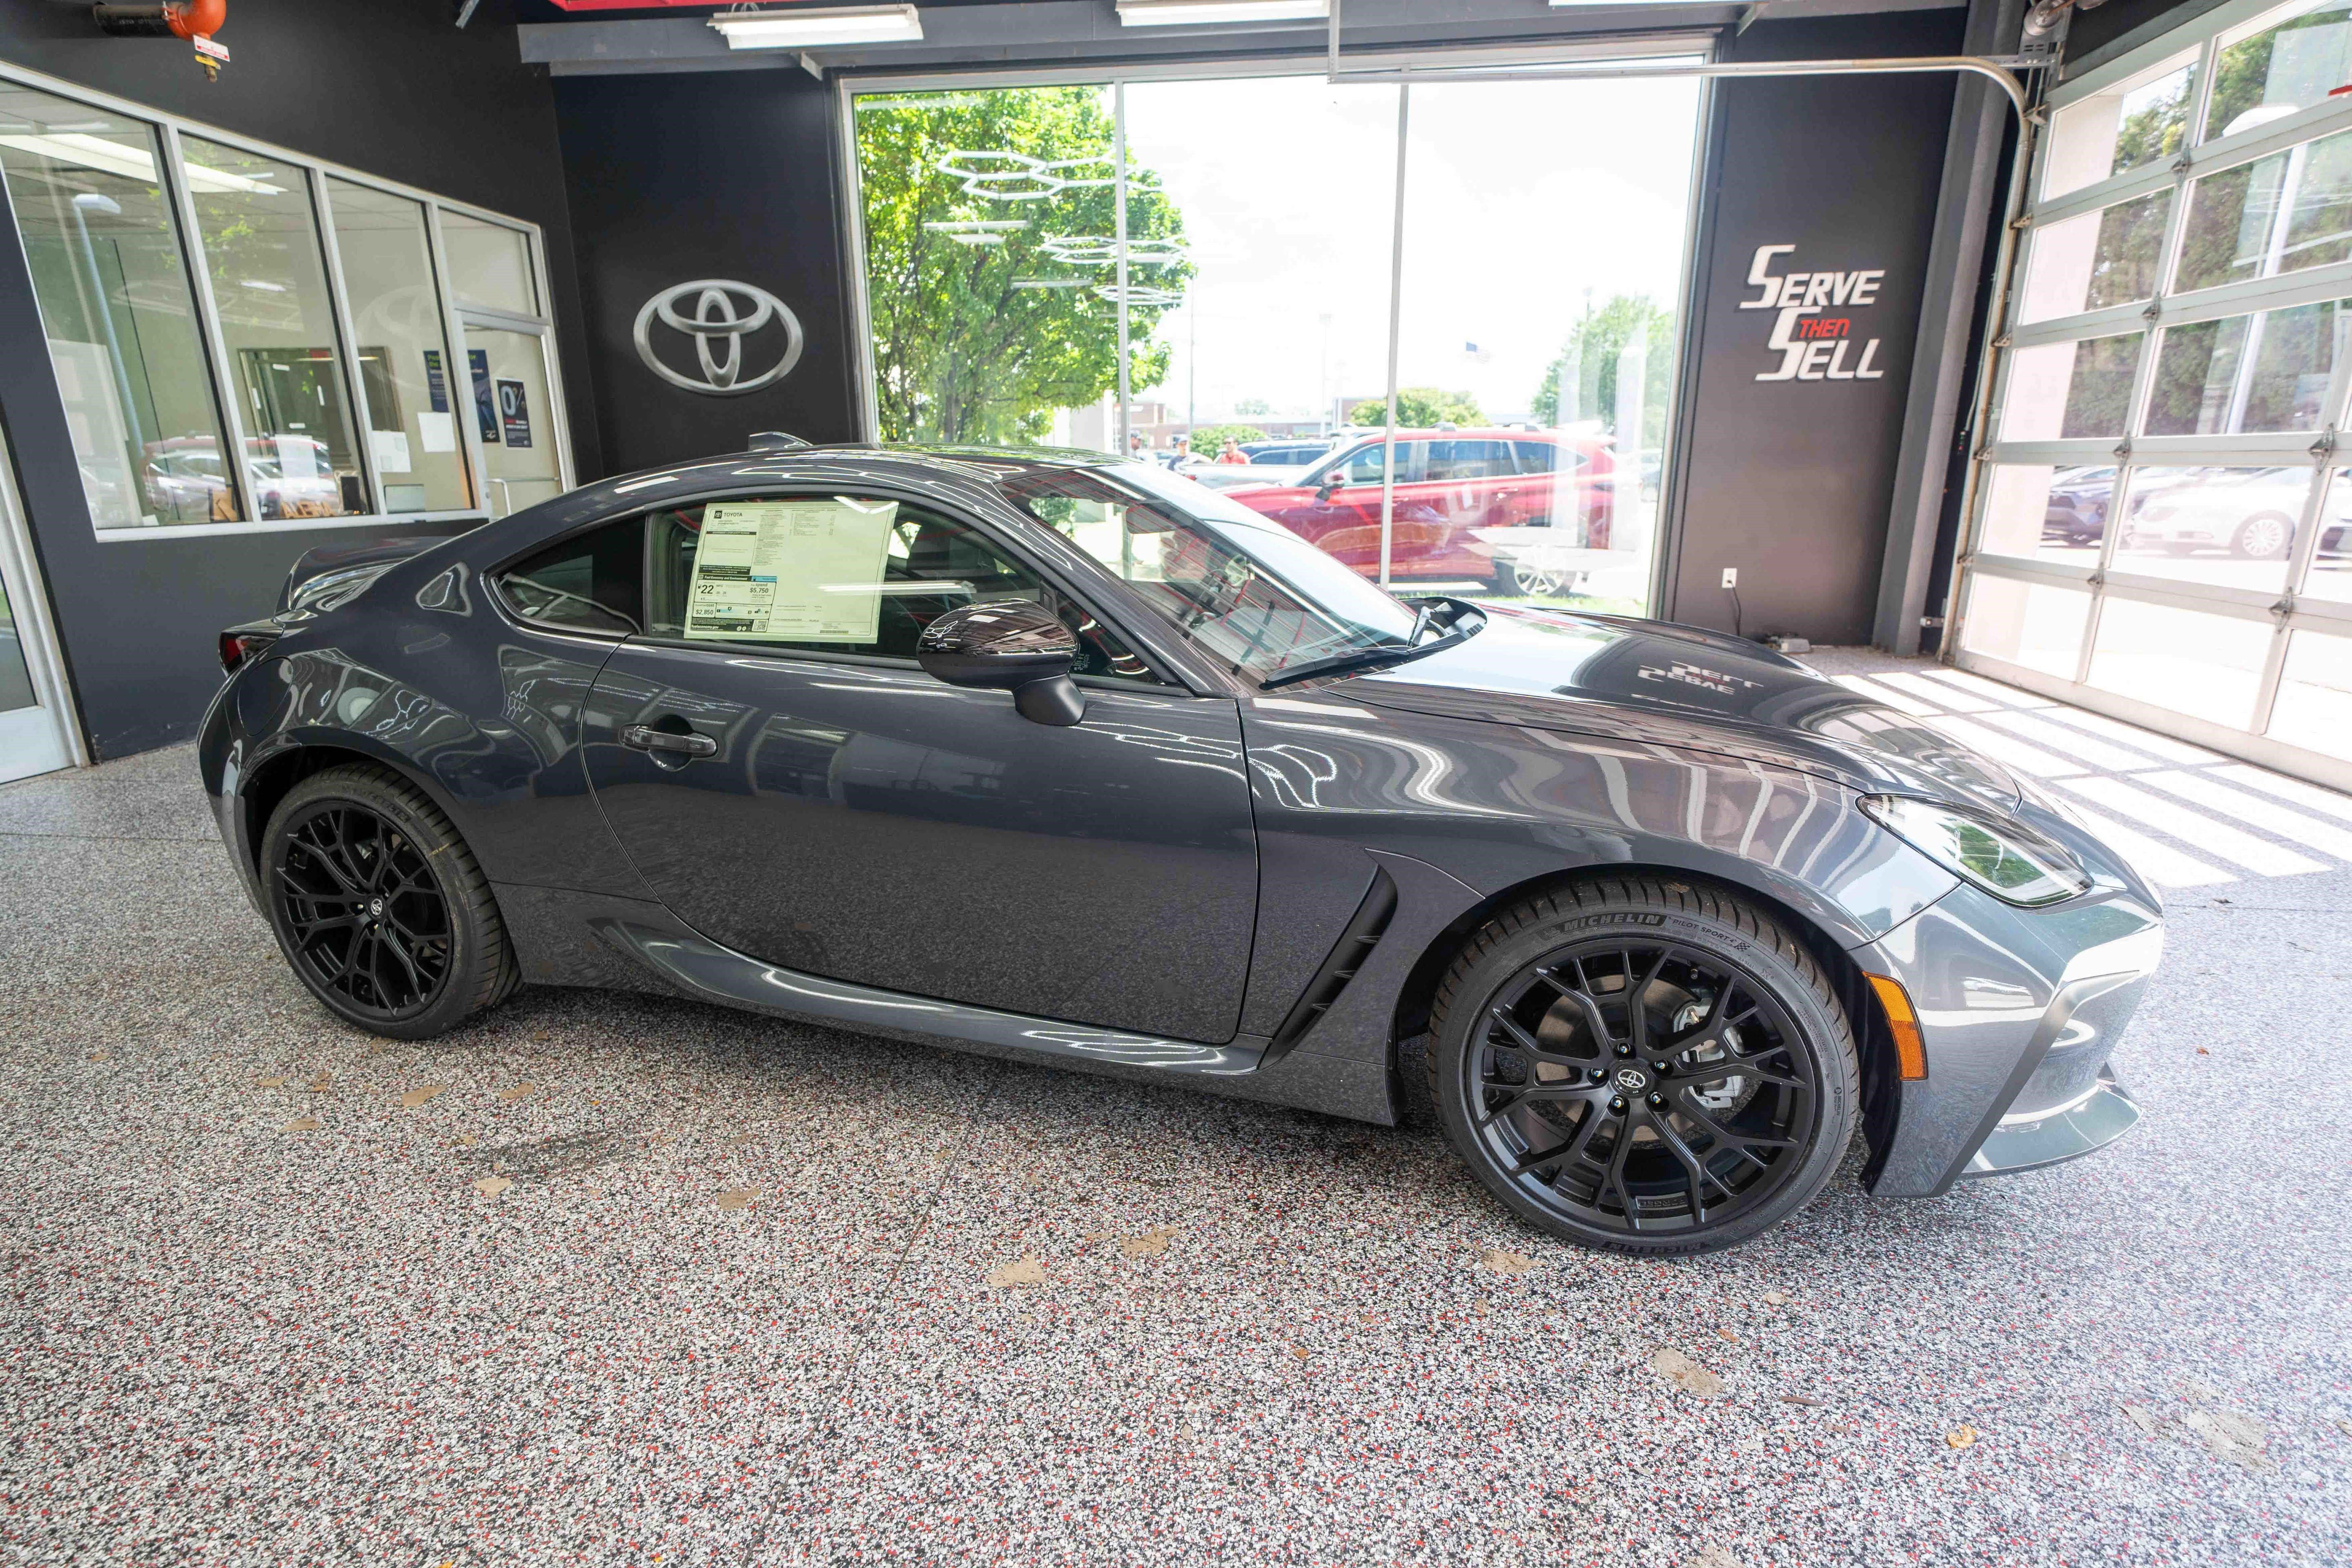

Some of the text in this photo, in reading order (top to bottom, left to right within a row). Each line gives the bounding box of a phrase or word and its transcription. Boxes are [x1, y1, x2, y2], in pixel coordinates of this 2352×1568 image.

[1739, 244, 1886, 309] SERVE
[1799, 318, 1850, 338] THEN
[1755, 306, 1884, 381] SELL
[701, 585, 714, 594] 22
[1564, 913, 1660, 931] MICHELIN
[1672, 919, 1699, 929] PILOT
[1700, 927, 1730, 940] SPORT
